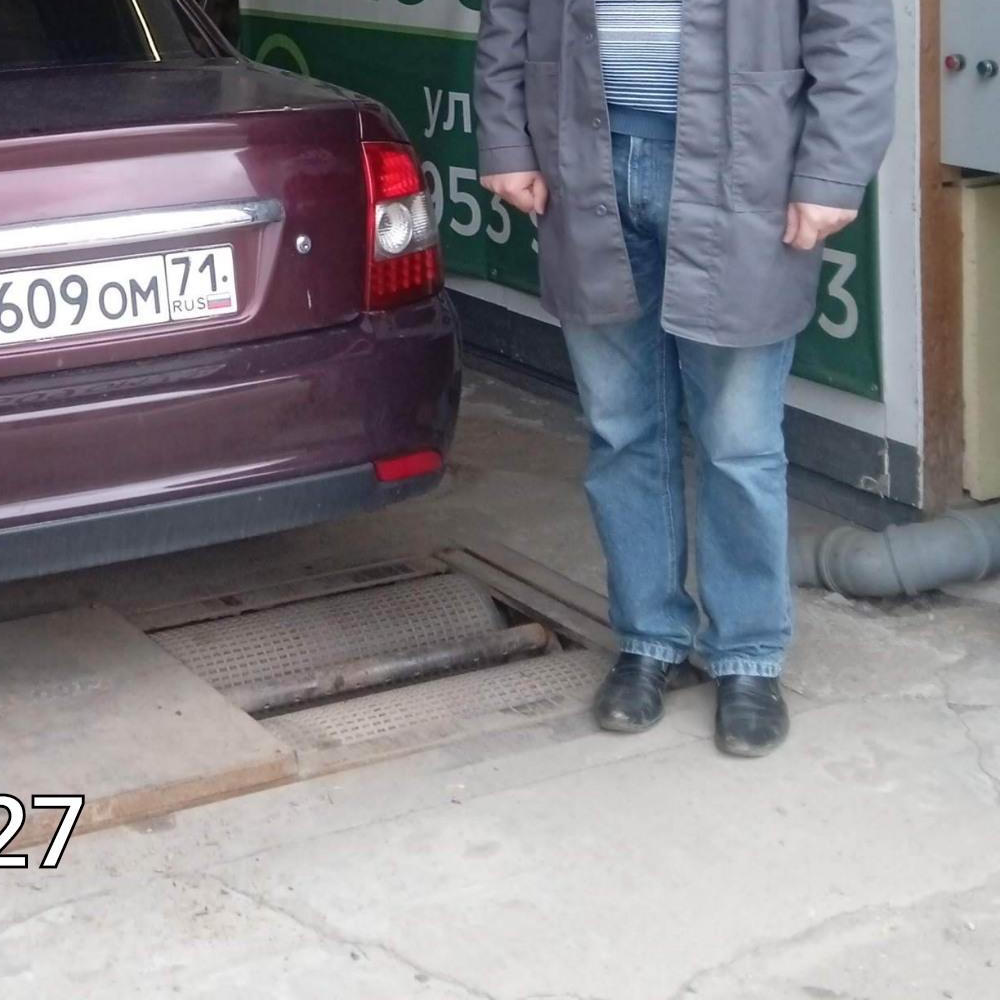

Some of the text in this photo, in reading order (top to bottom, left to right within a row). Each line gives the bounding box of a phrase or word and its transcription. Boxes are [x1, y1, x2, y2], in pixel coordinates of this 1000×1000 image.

[171, 253, 218, 297] 71
[818, 247, 858, 339] 3
[172, 297, 206, 313] RUS
